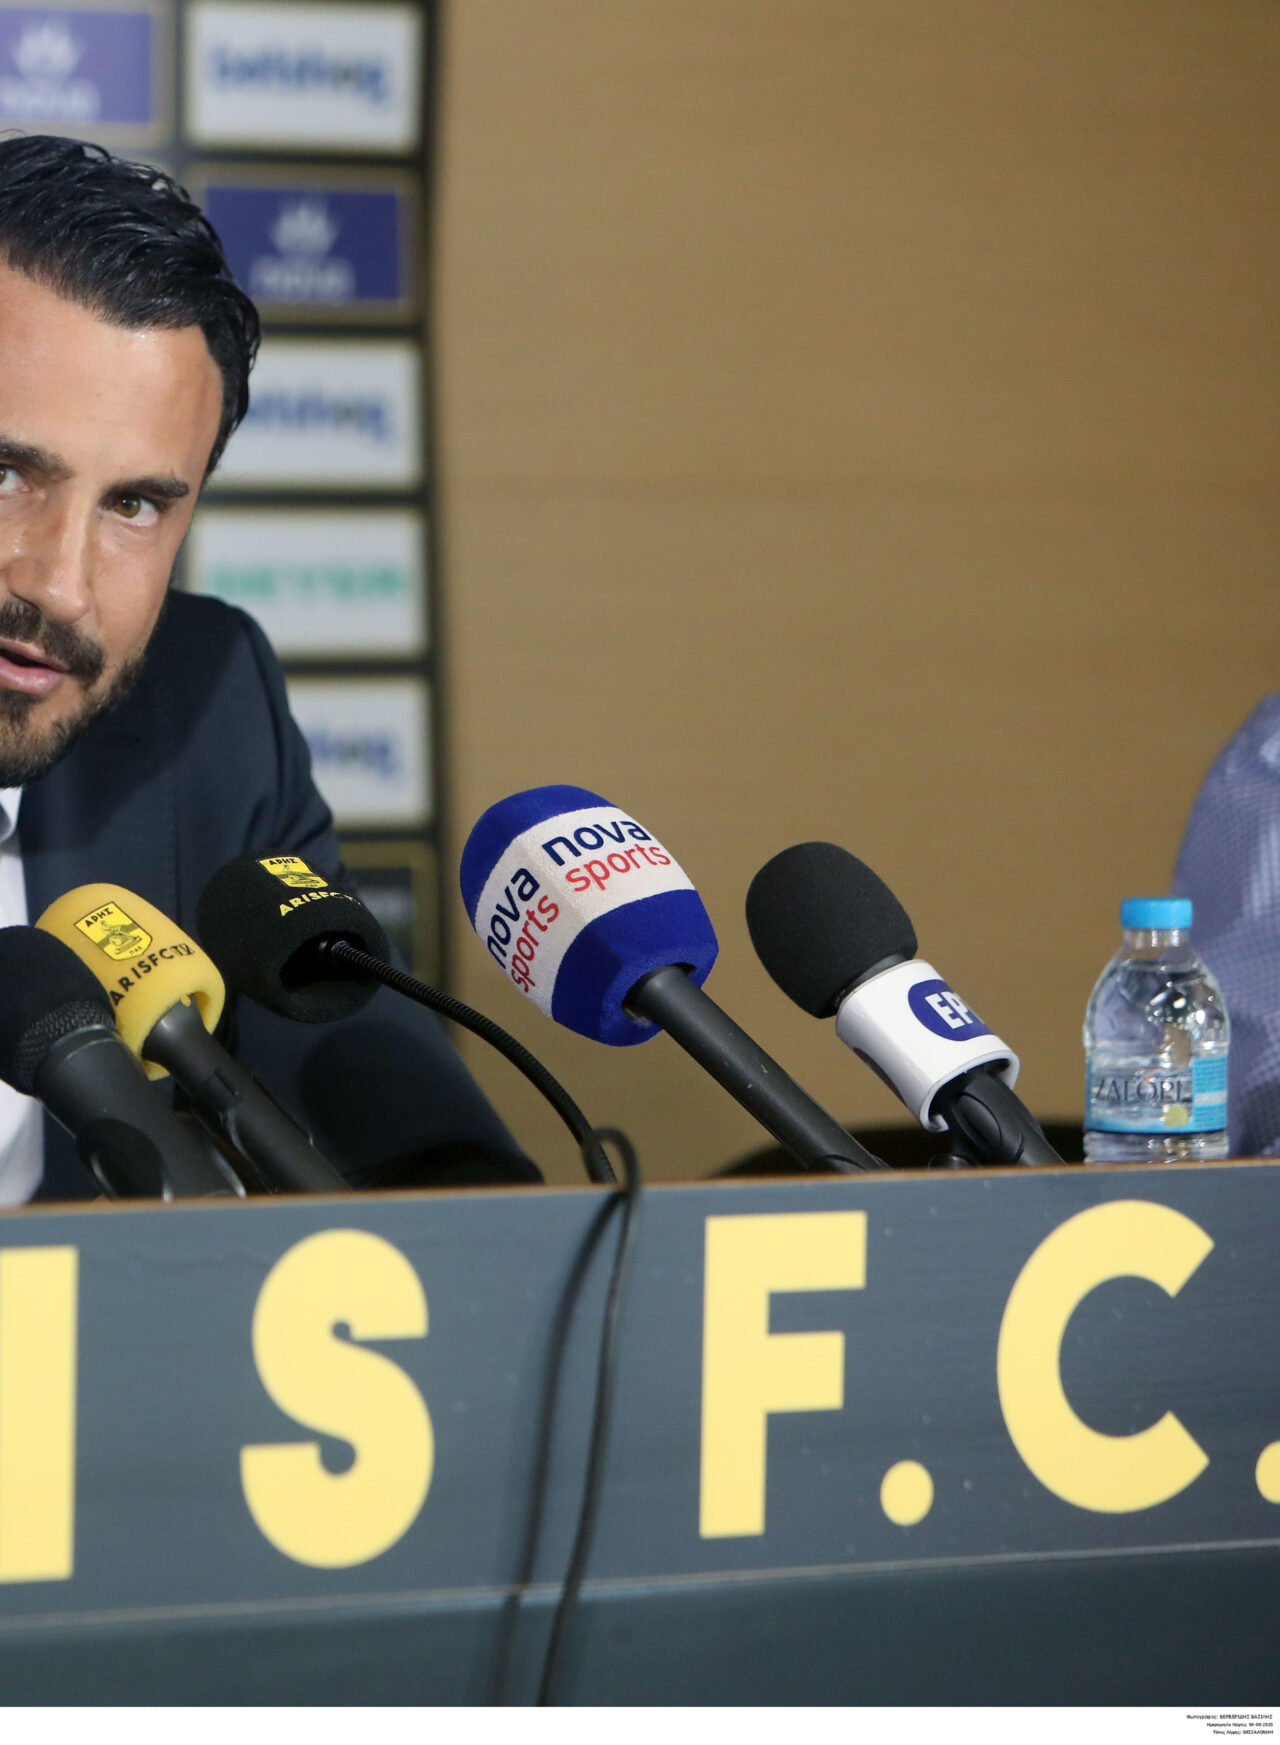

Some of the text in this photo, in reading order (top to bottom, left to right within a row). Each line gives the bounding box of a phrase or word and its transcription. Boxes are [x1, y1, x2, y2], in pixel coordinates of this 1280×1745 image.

[541, 819, 652, 867] nova
[565, 843, 672, 892] sports
[485, 867, 541, 970] nova
[510, 894, 560, 994] sports
